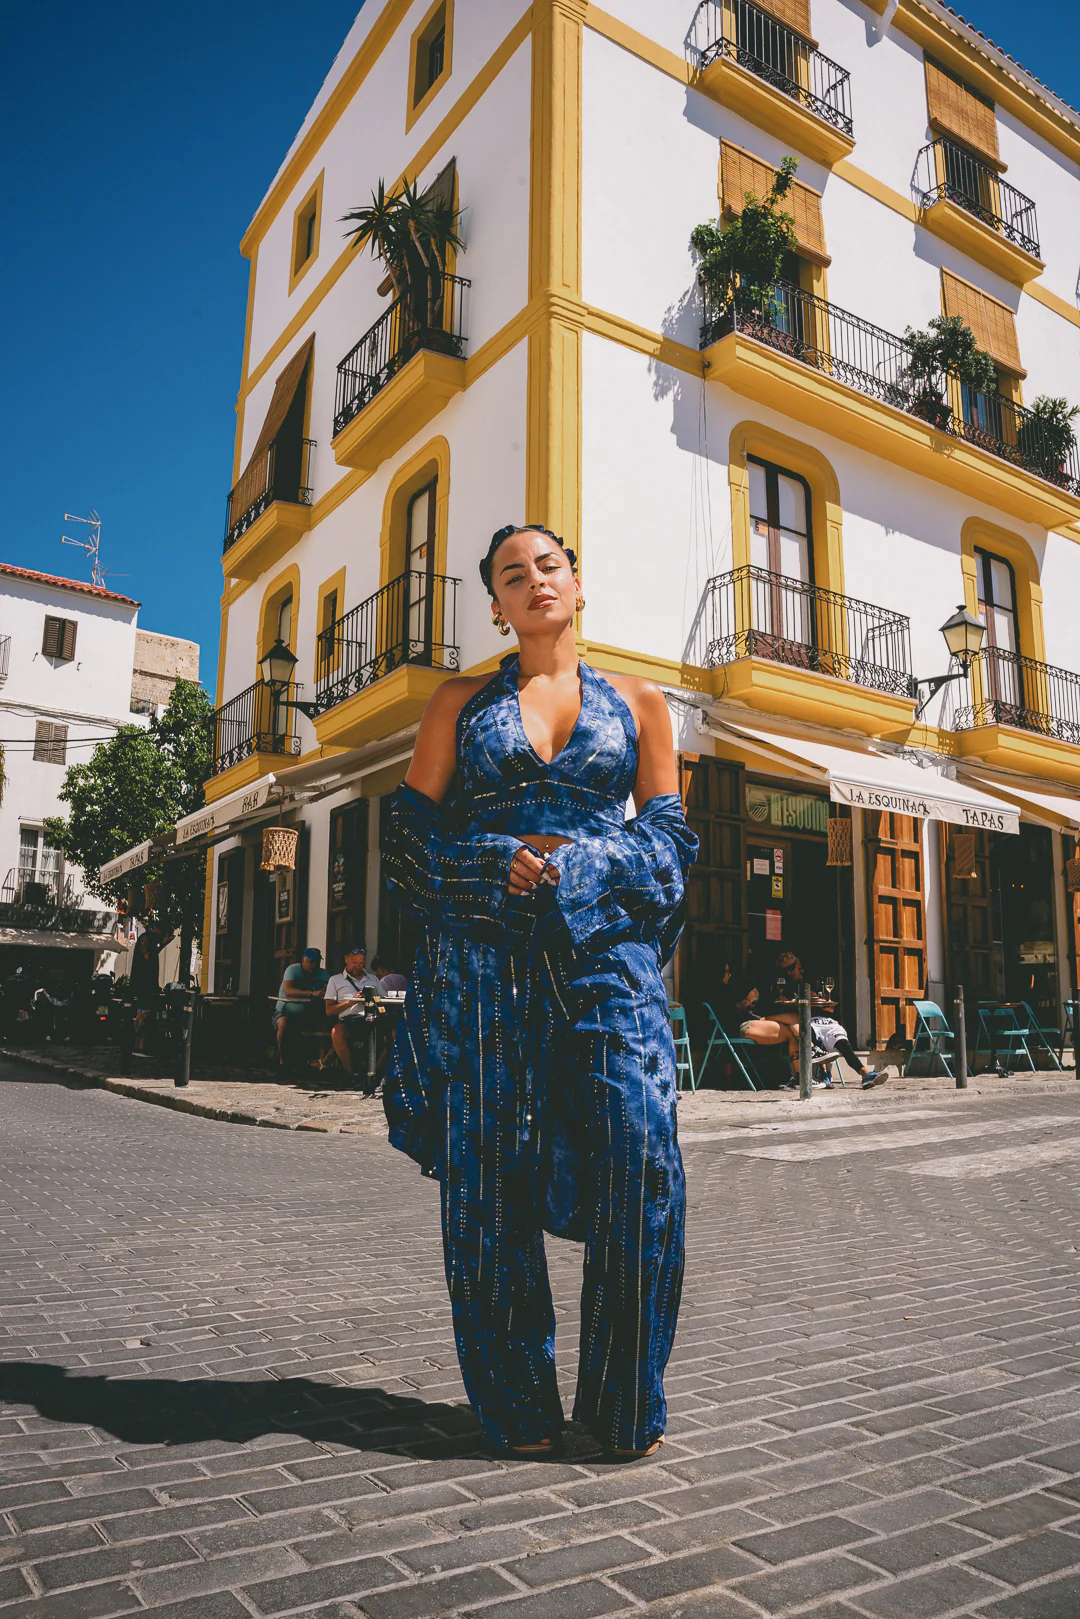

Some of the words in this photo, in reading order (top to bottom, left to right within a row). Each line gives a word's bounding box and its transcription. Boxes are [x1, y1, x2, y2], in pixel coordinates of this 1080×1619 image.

[241, 791, 259, 813] BAR
[850, 788, 865, 804] LA
[868, 792, 919, 815] ESQUINA
[182, 828, 189, 839] LA
[189, 817, 211, 835] ESQUINA
[962, 808, 1004, 831] TAPAS
